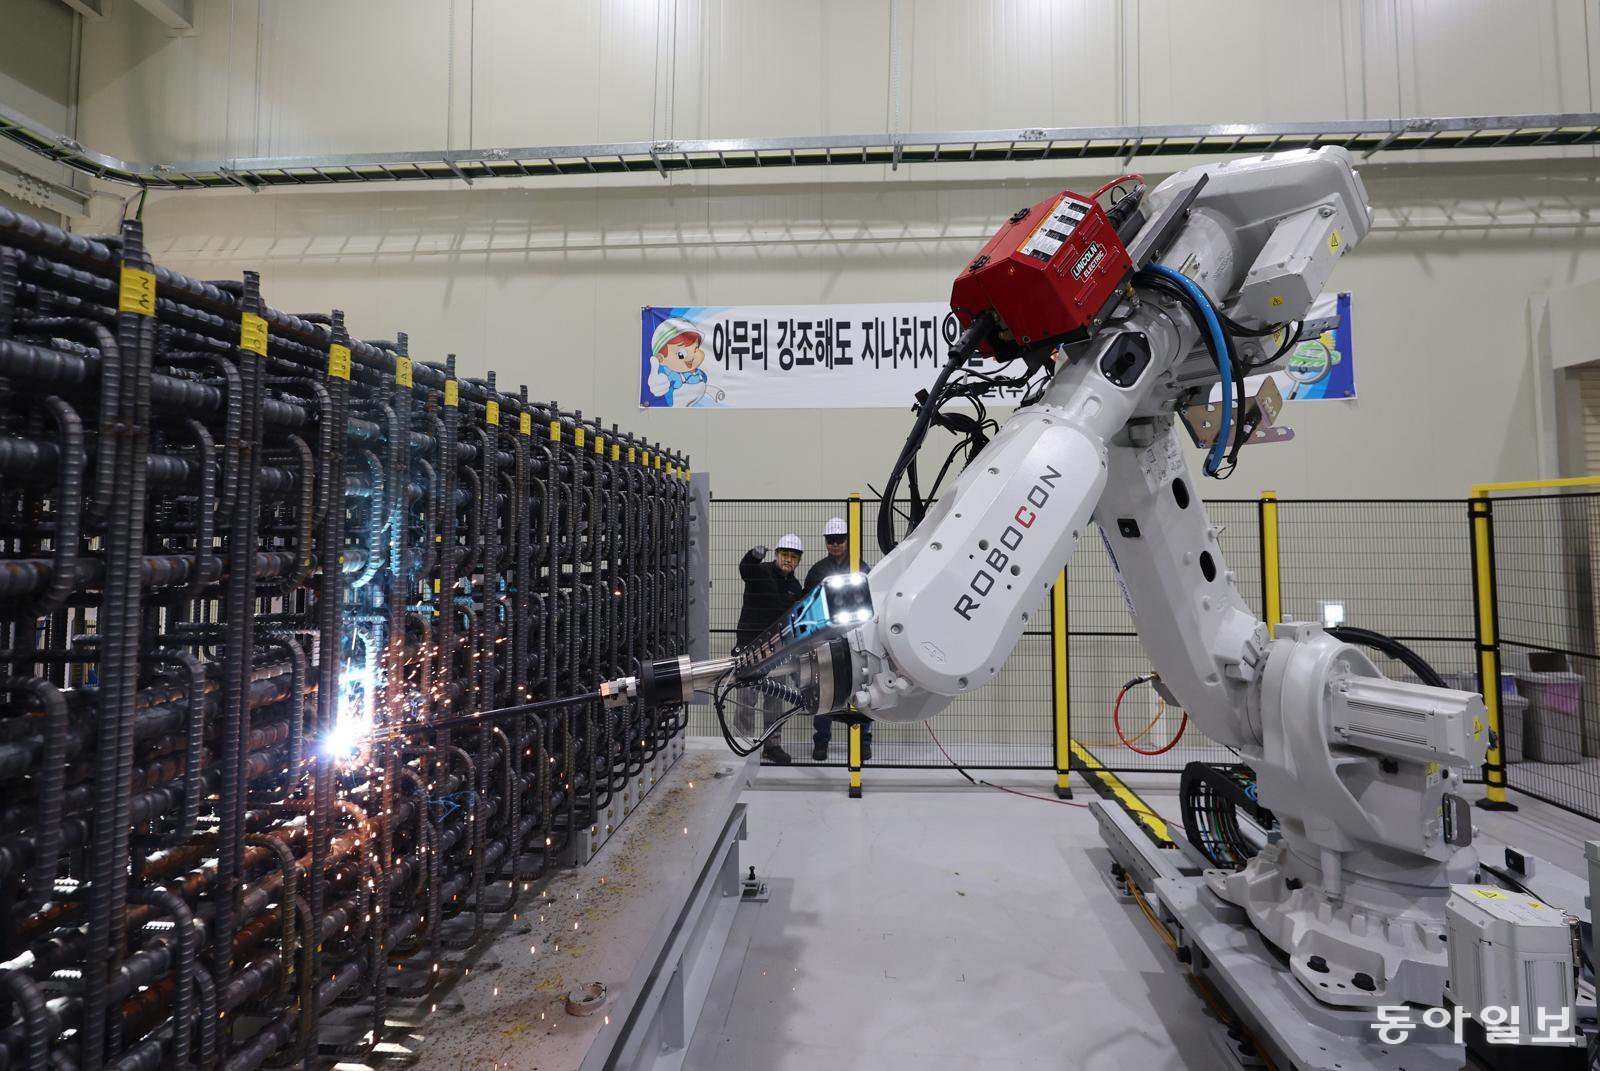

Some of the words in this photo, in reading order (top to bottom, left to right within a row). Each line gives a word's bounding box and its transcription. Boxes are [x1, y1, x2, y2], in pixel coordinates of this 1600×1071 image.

[1073, 243, 1098, 277] LINCOLN
[1083, 250, 1105, 278] ELECTRIC
[712, 318, 768, 371] 아무리
[776, 317, 854, 371] 강조해도
[861, 315, 938, 370] 지나치지
[953, 464, 1063, 622] ROBOCON
